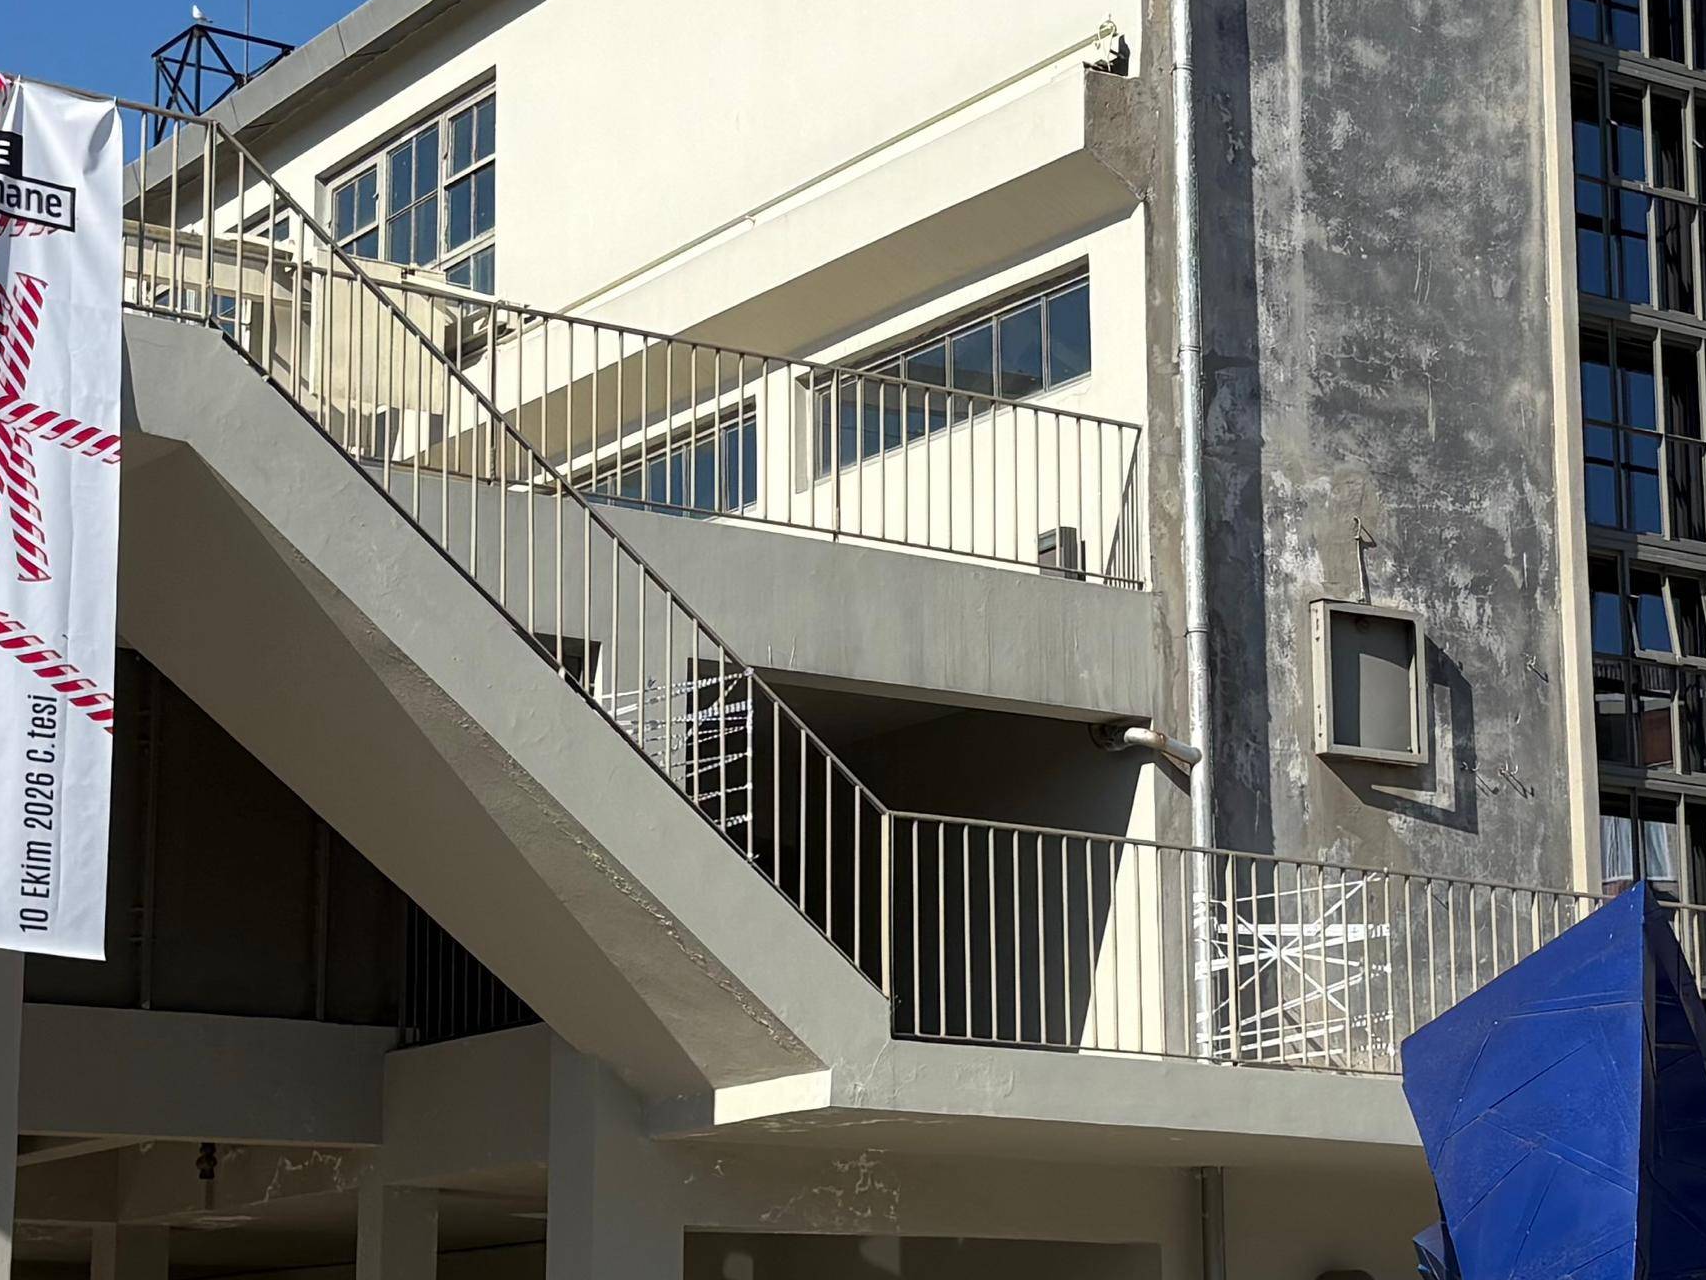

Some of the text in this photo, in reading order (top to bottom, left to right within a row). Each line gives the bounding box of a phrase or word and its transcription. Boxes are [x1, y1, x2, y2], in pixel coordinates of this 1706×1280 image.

[19, 694, 58, 933] 10 Ekim 2026 C.tesi
